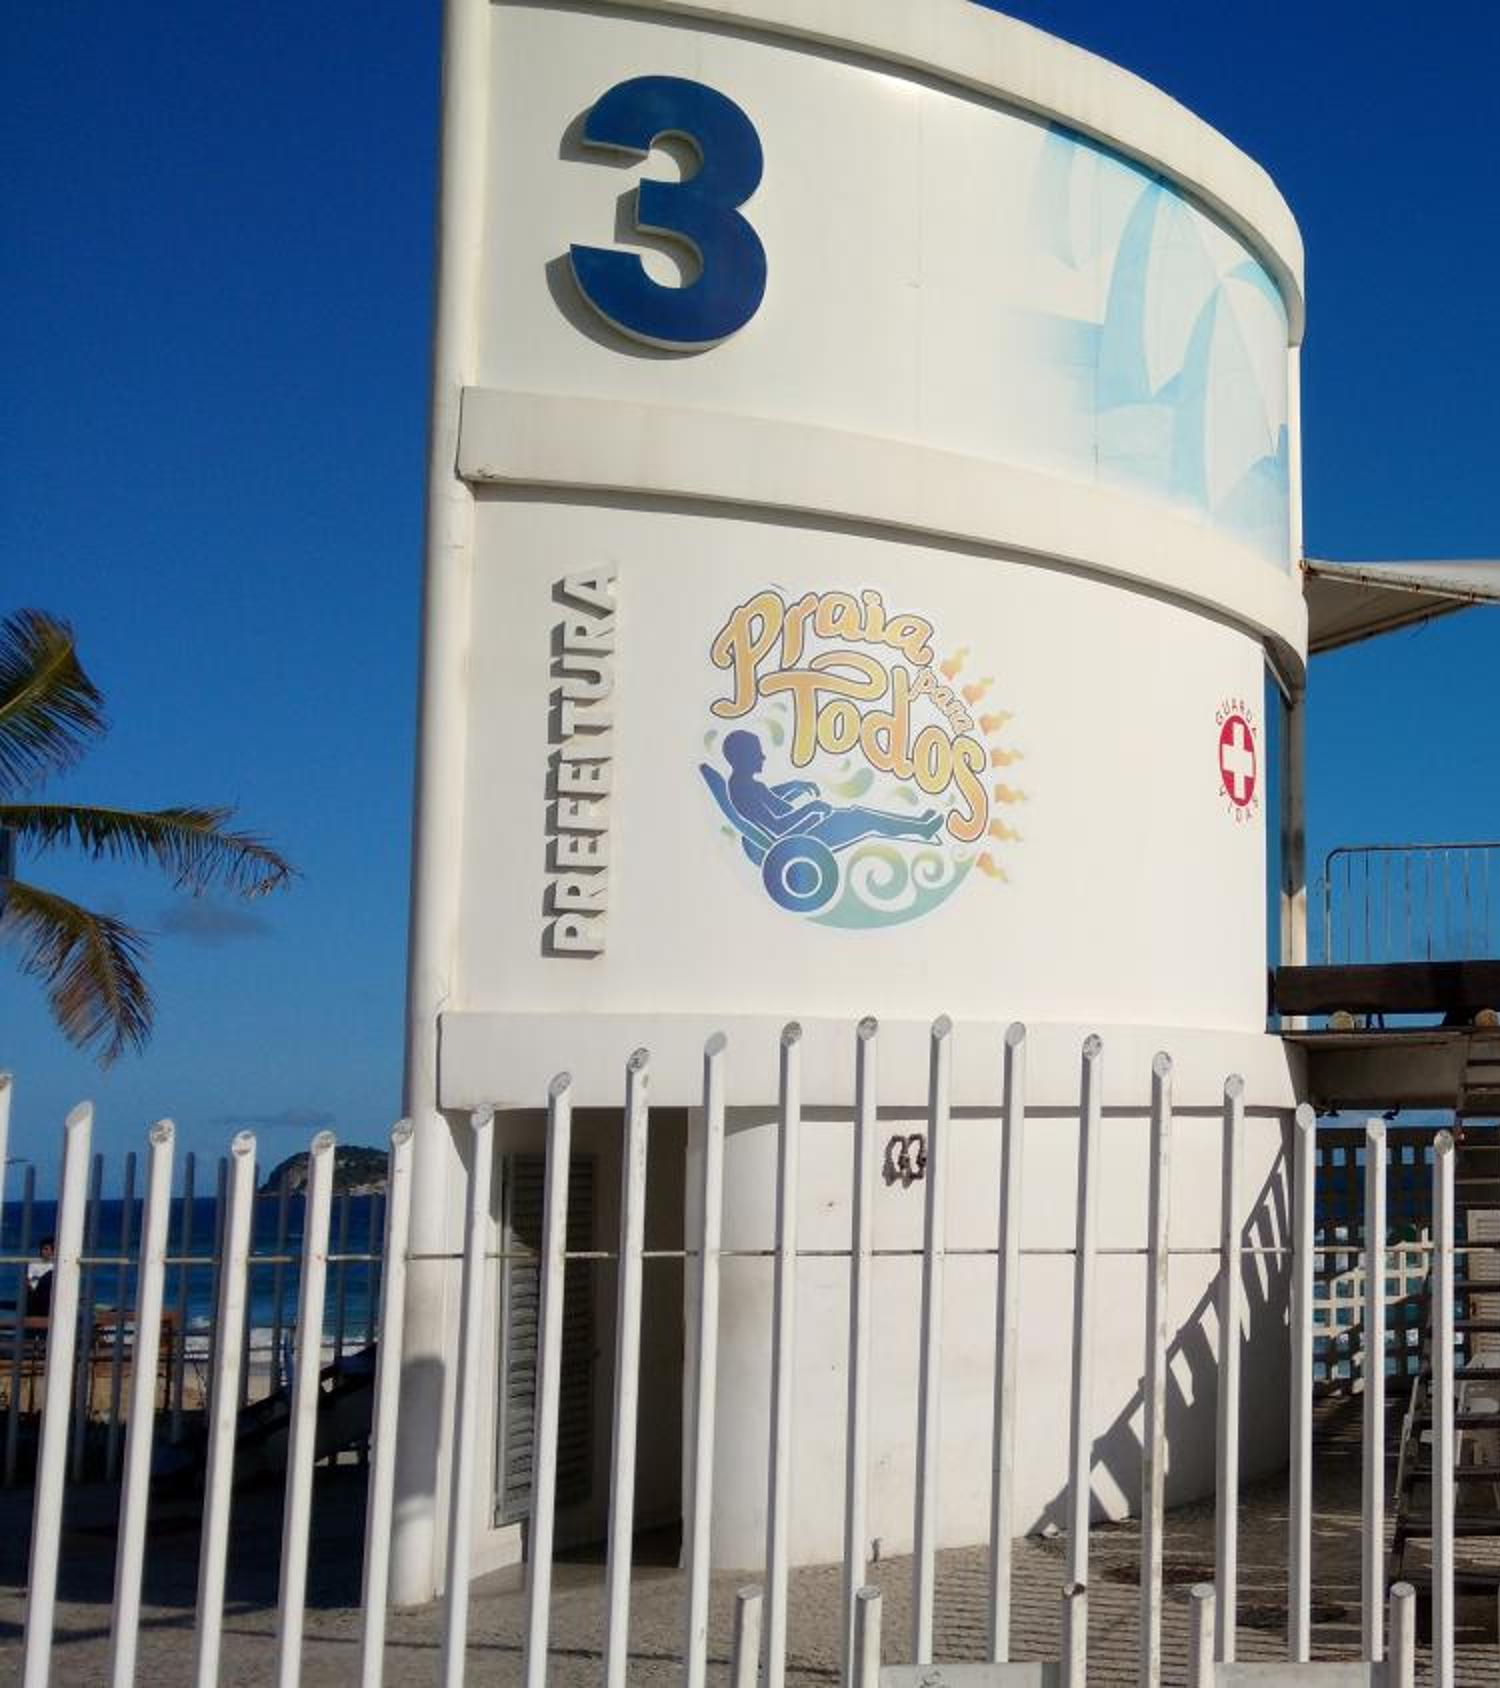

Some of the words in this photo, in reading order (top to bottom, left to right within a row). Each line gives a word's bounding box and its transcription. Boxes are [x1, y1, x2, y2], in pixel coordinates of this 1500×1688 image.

[570, 76, 767, 342] 3
[544, 560, 617, 958] PREFEITURA
[709, 590, 934, 718] Praia
[759, 650, 988, 842] Todos
